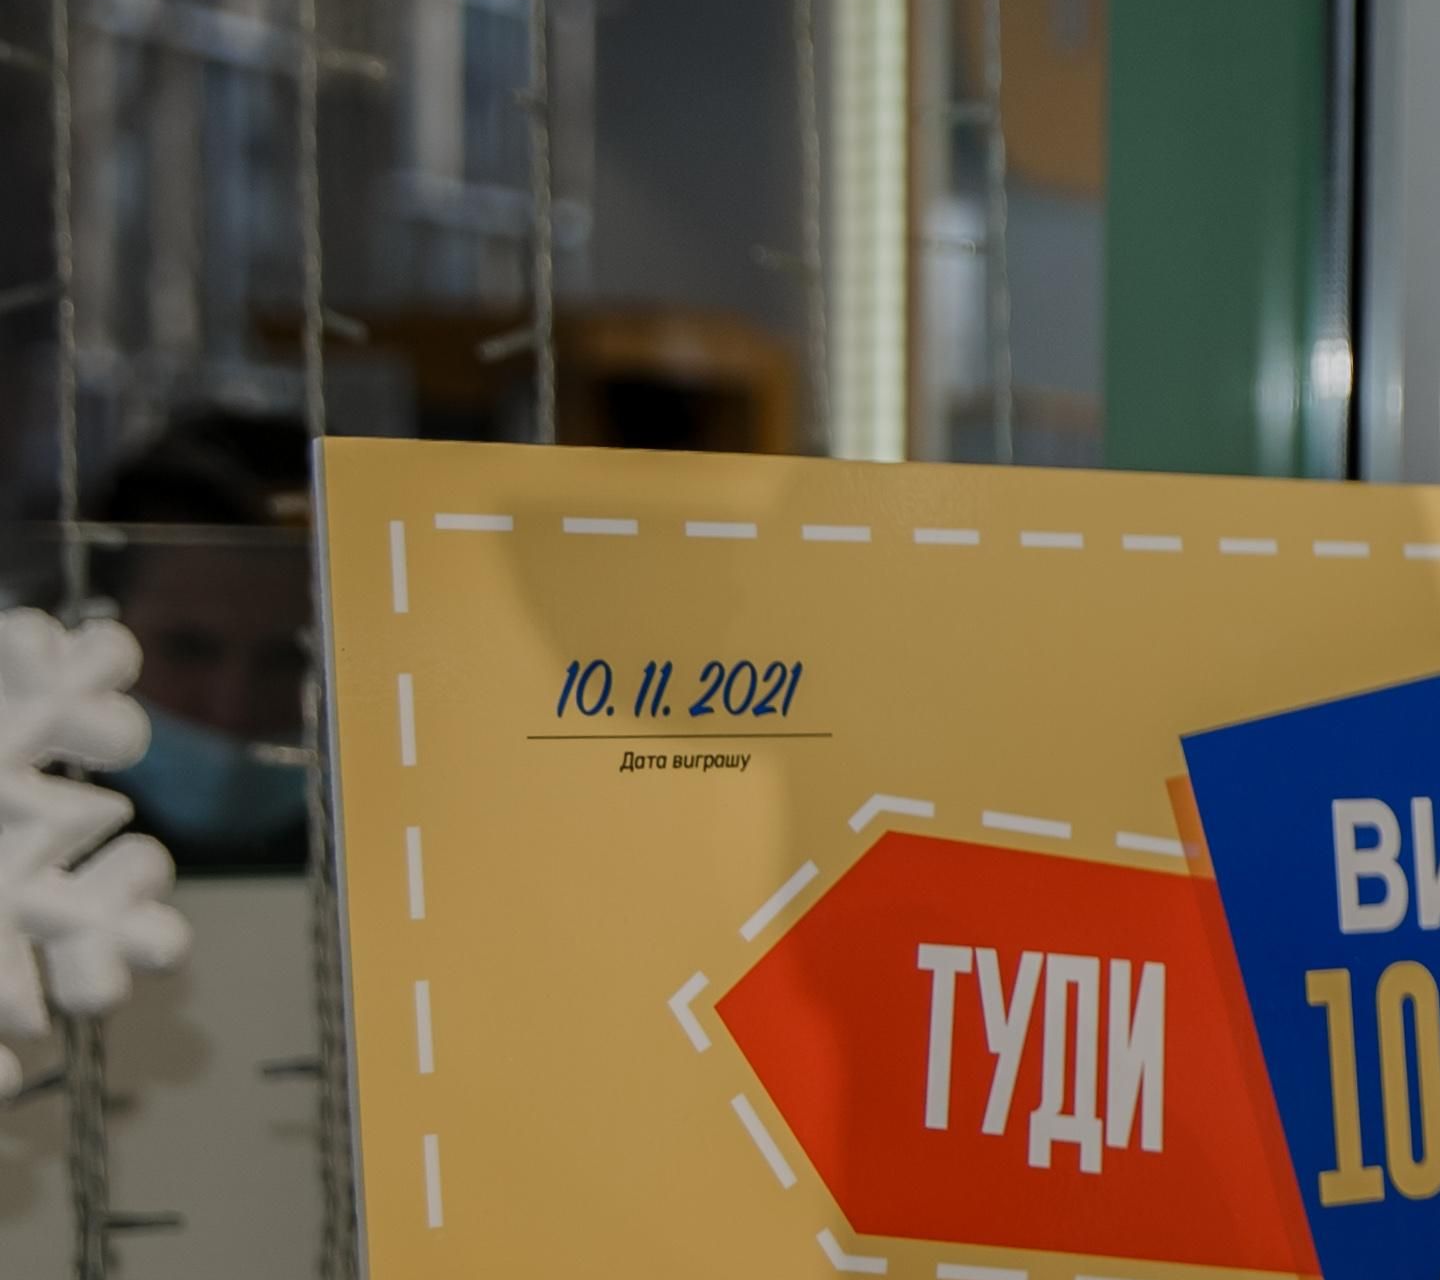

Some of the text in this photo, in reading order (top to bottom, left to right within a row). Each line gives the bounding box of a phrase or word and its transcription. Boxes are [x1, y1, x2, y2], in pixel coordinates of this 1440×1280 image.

[556, 659, 803, 718] 10. 11. 2021
[618, 751, 752, 773] Дата виграшу
[917, 942, 1166, 1175] ТУДИ
